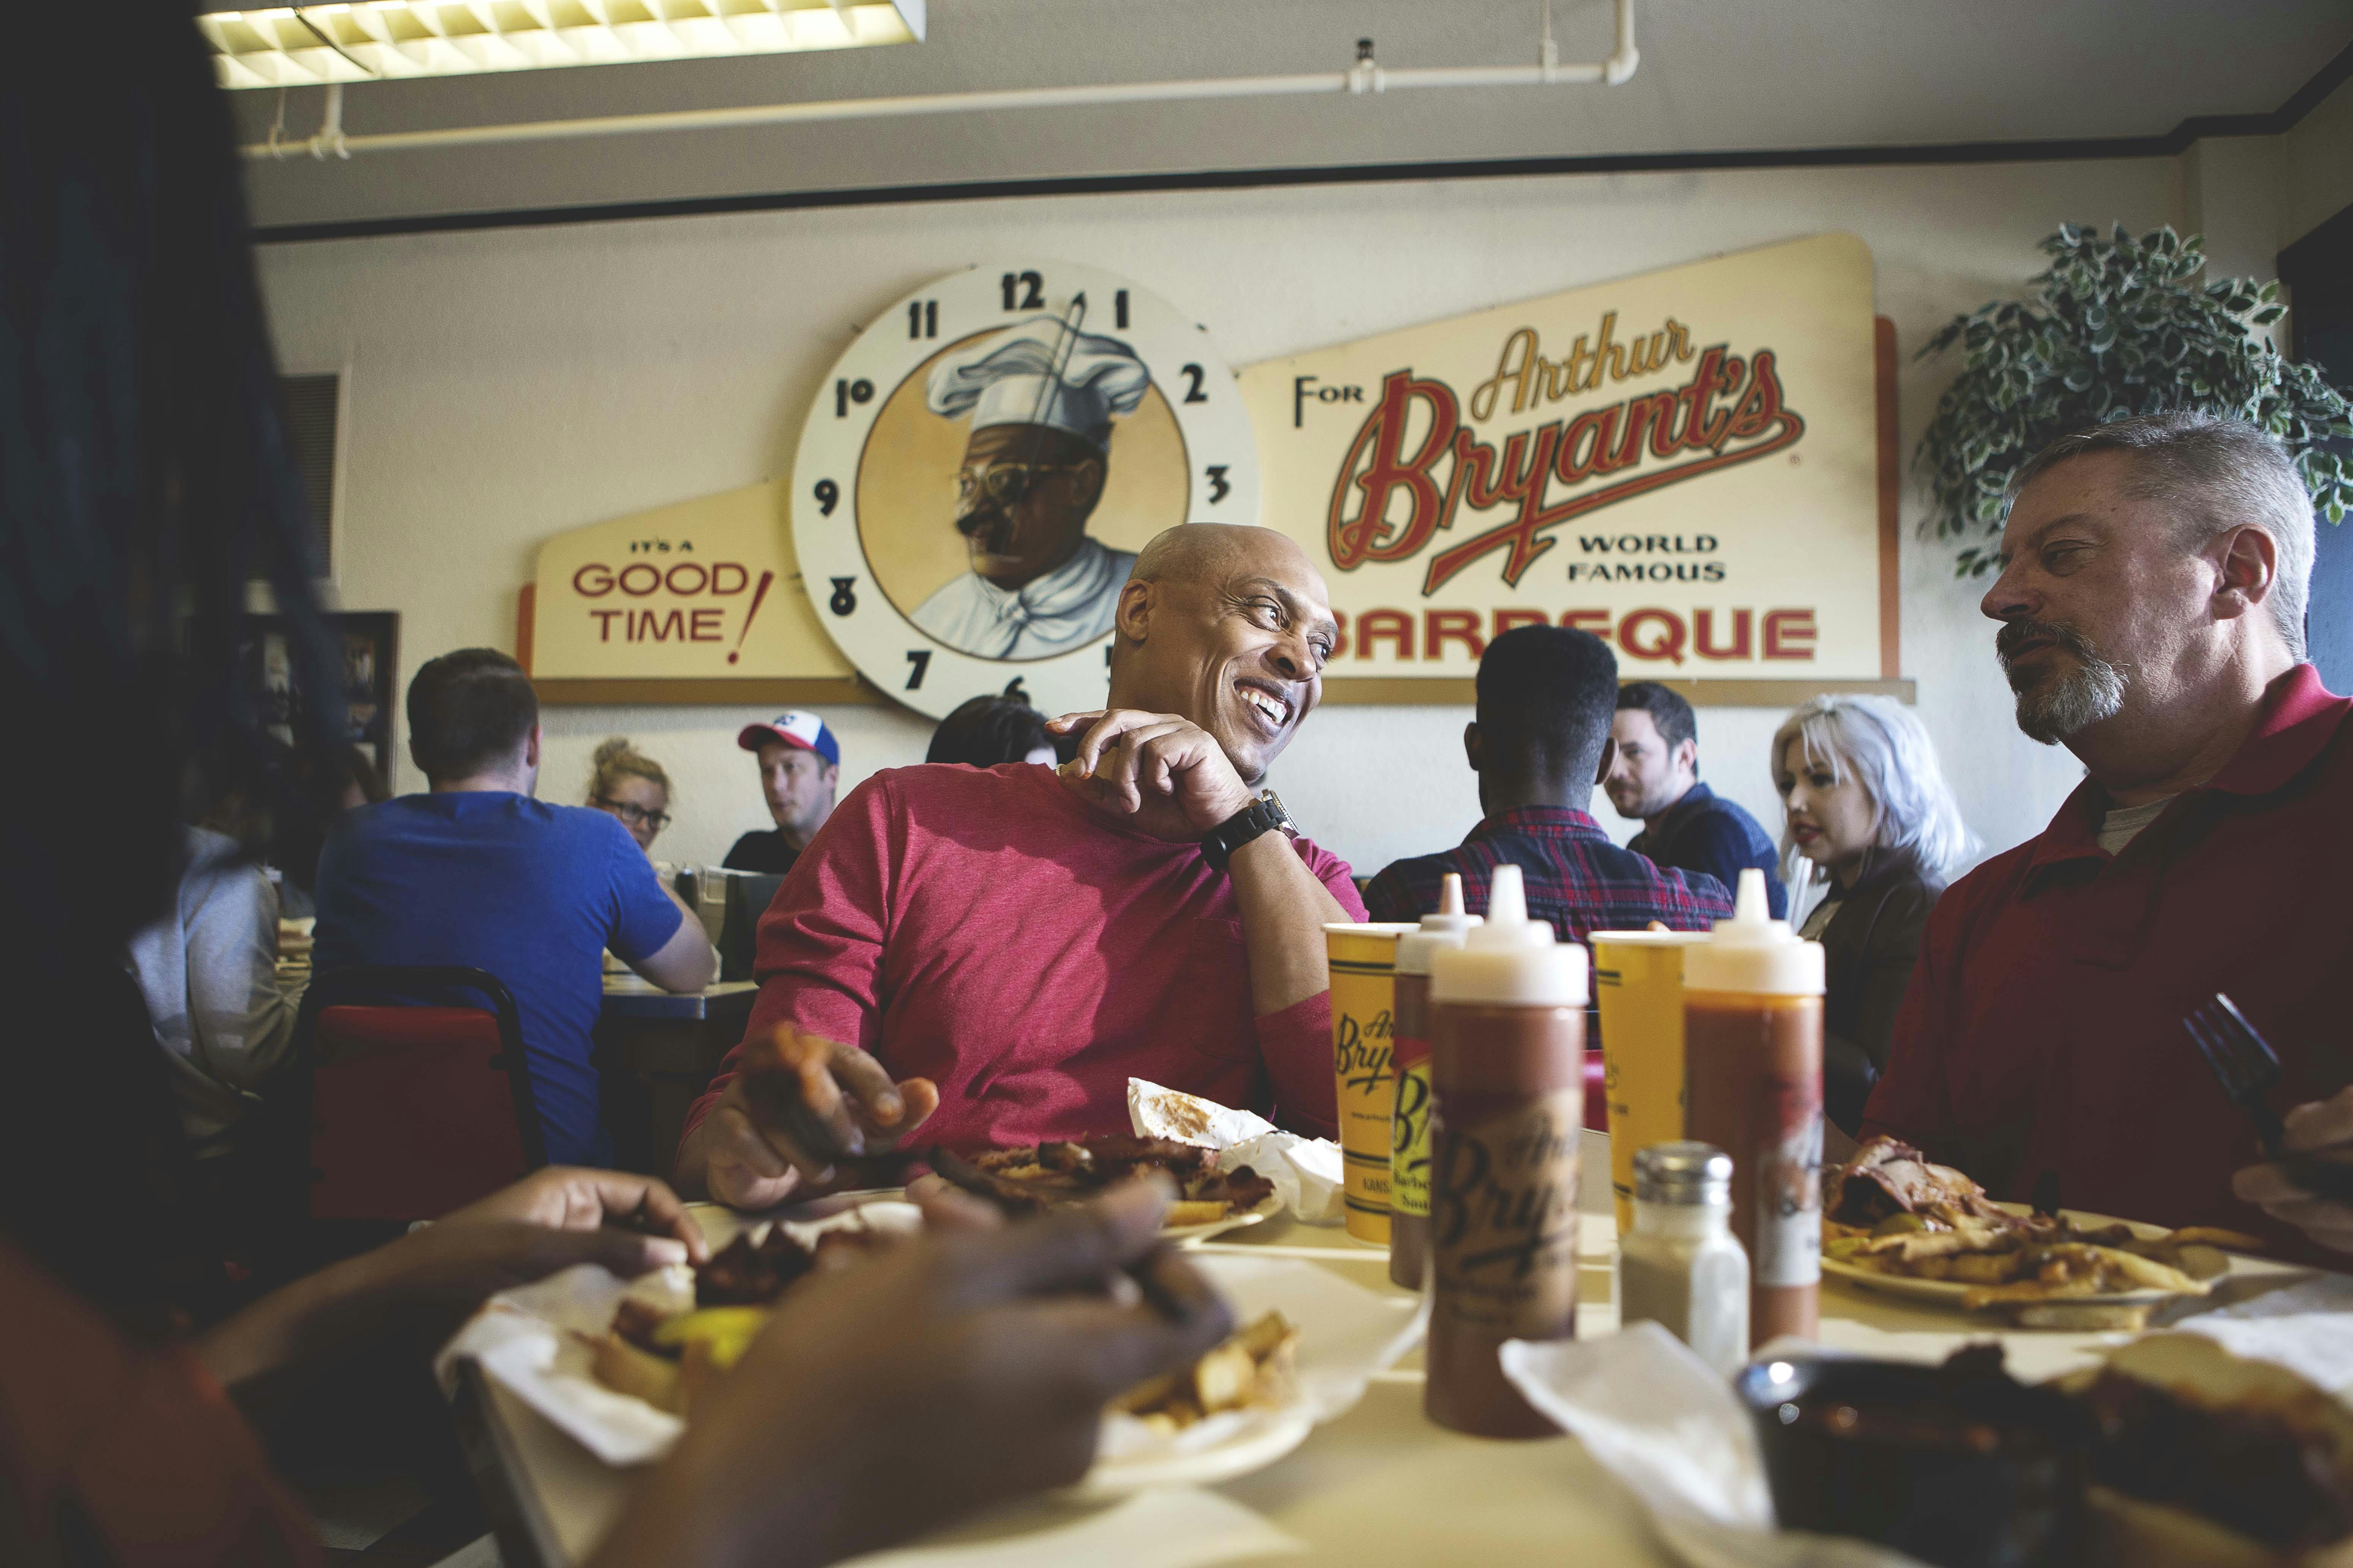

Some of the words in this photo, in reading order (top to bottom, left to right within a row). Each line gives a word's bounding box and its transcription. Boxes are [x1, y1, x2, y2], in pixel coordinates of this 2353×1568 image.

[1002, 269, 1045, 311] 12
[1116, 290, 1129, 328] 1
[909, 300, 938, 338] 11
[1181, 363, 1208, 404] 2
[1470, 311, 1694, 421] Arthur
[836, 379, 874, 416] 10
[1205, 465, 1230, 504] 3
[1327, 342, 1805, 597] Bryant's
[814, 478, 838, 517] 9
[630, 538, 671, 552] IT'S
[679, 540, 693, 552] A
[1579, 534, 1718, 554] WORLD
[573, 562, 749, 597] GOOD
[1568, 562, 1726, 582] FAMOUS
[830, 576, 857, 617] 8
[905, 651, 932, 689] 7
[1363, 1177, 1391, 1195] KANS
